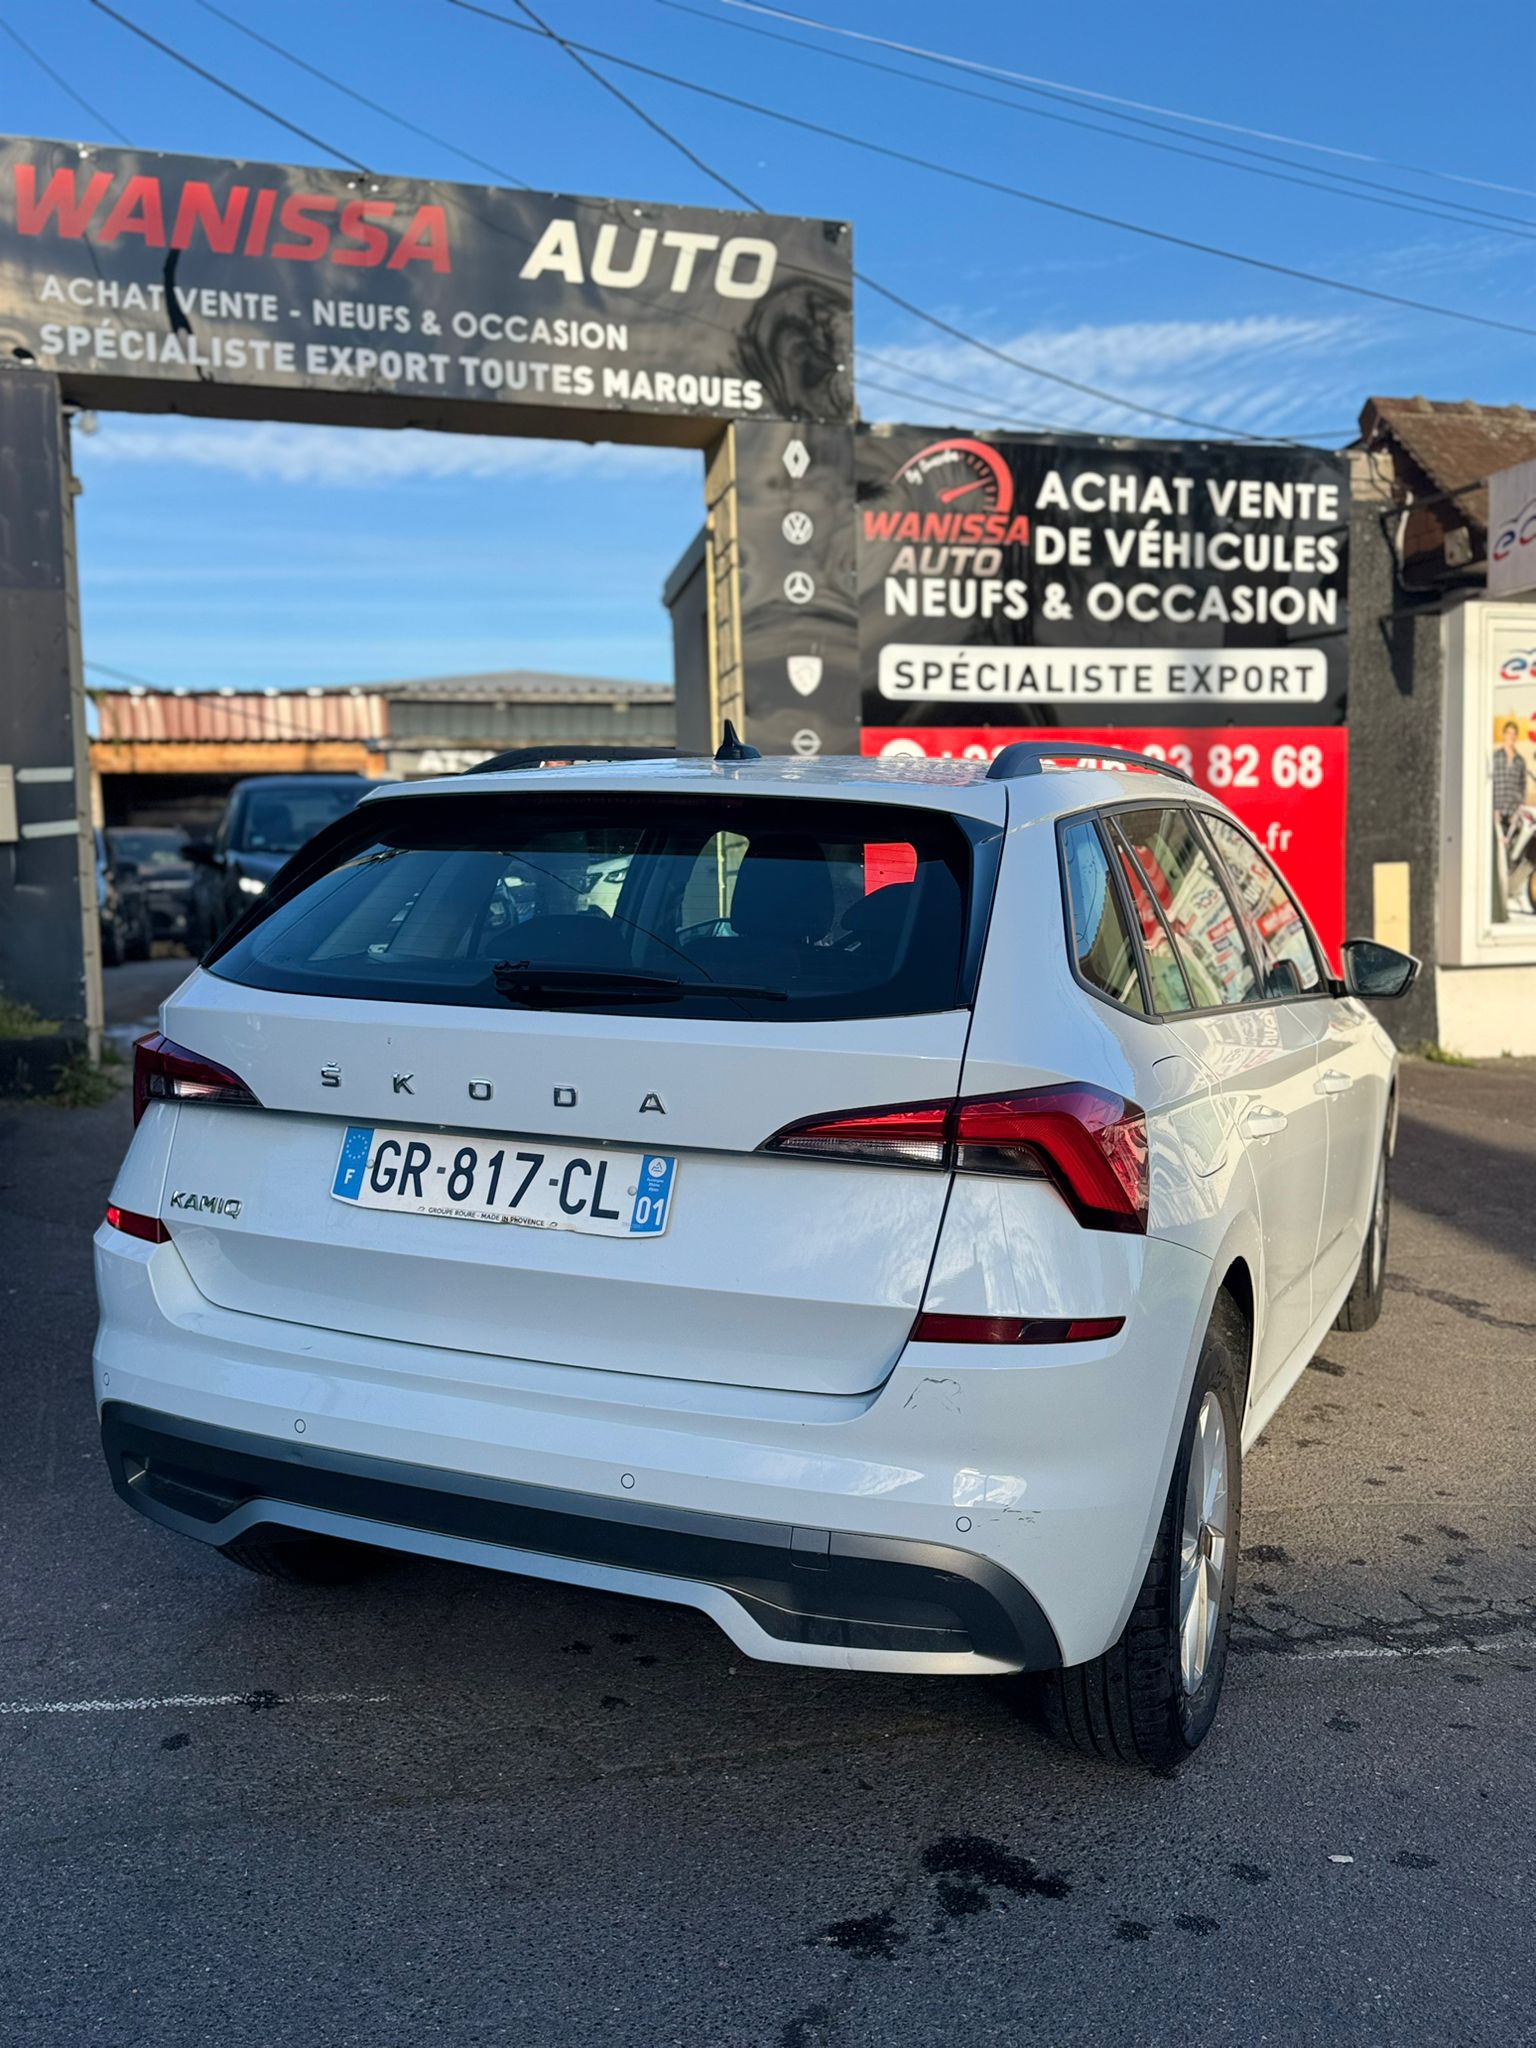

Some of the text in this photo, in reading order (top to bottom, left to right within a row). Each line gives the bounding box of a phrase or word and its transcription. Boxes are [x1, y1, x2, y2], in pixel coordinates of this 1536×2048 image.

[15, 163, 778, 300] WANISSA AUTO
[41, 274, 164, 311] ACHAT
[174, 286, 278, 323] VENTE
[313, 299, 411, 333] NEUFS
[421, 310, 442, 336] &
[452, 311, 628, 351] OCCASION
[40, 318, 763, 410] SPÉCIALISTE EXPORT TOUTES MARQUES
[1035, 470, 1338, 521] ACHAT VENTE
[864, 511, 1030, 546] WANISSA
[1035, 518, 1339, 574] DE VÉHICULES
[889, 546, 1003, 577] AUTO
[884, 578, 1337, 625] NEUFS & OCCASION
[894, 652, 1314, 694] SPÉCIALISTE EXPORT
[1207, 744, 1260, 788] 82
[1271, 745, 1323, 788] 68
[344, 1169, 355, 1185] F
[370, 1139, 619, 1220] GR-817-CL
[170, 1191, 242, 1219] KAMIQ
[481, 1212, 499, 1221] MADE
[510, 1216, 545, 1227] PROVENCE
[636, 1196, 664, 1226] 01
